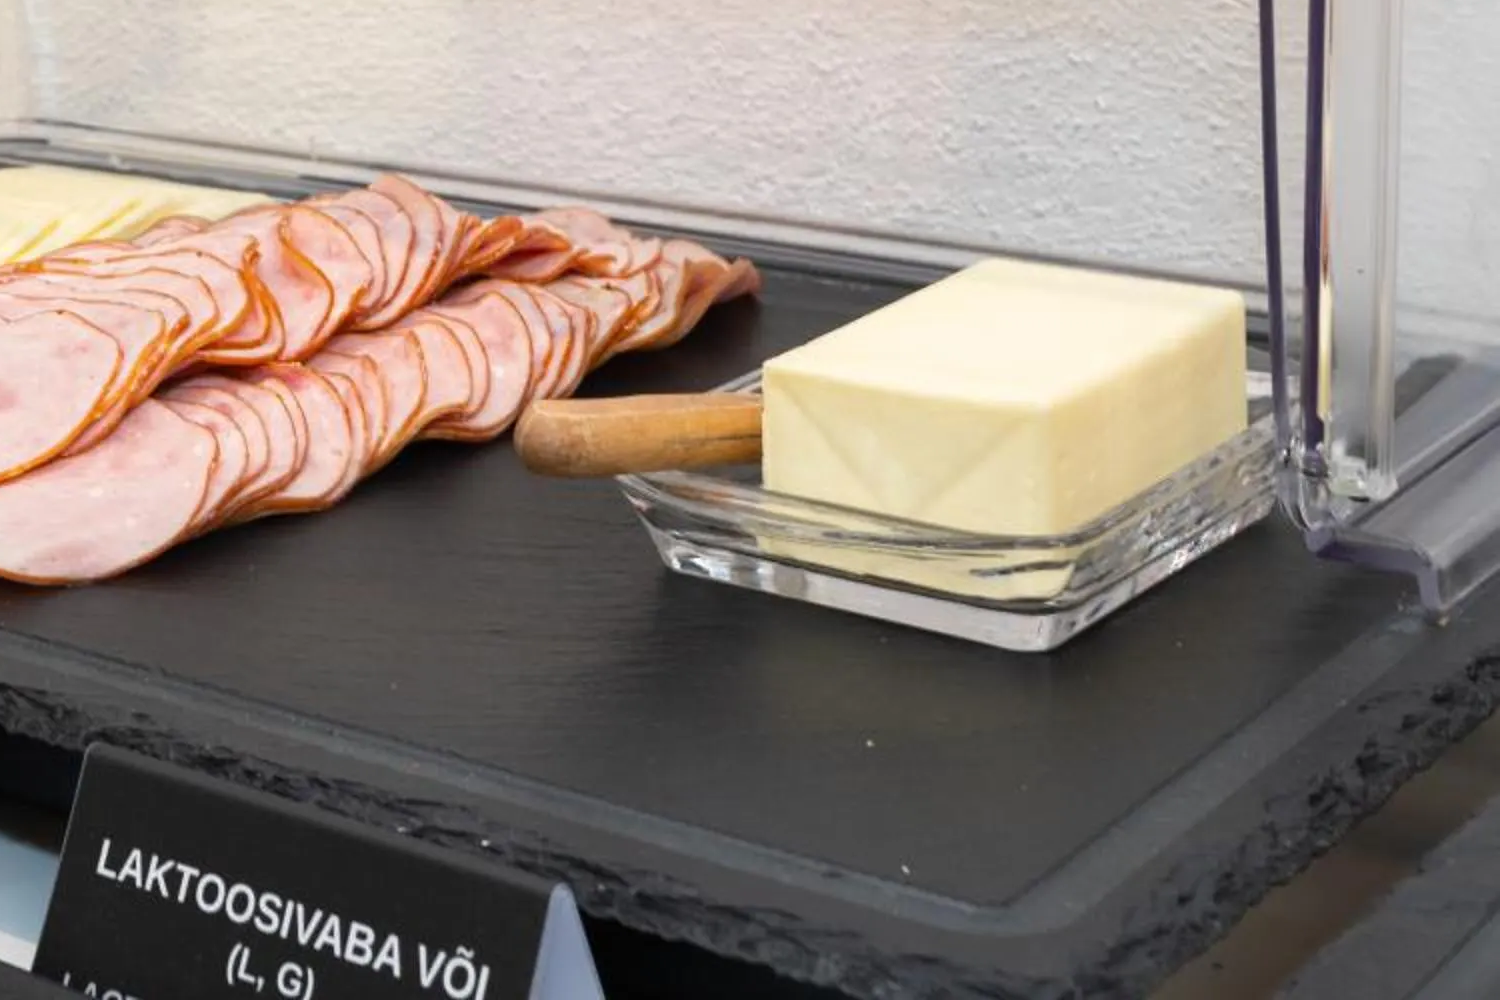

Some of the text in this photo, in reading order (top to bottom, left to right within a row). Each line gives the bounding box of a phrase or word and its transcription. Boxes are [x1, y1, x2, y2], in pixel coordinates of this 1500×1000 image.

[97, 838, 491, 1000] LAKTOOSIVABA VÕI
[226, 942, 315, 1000] (L, G)
